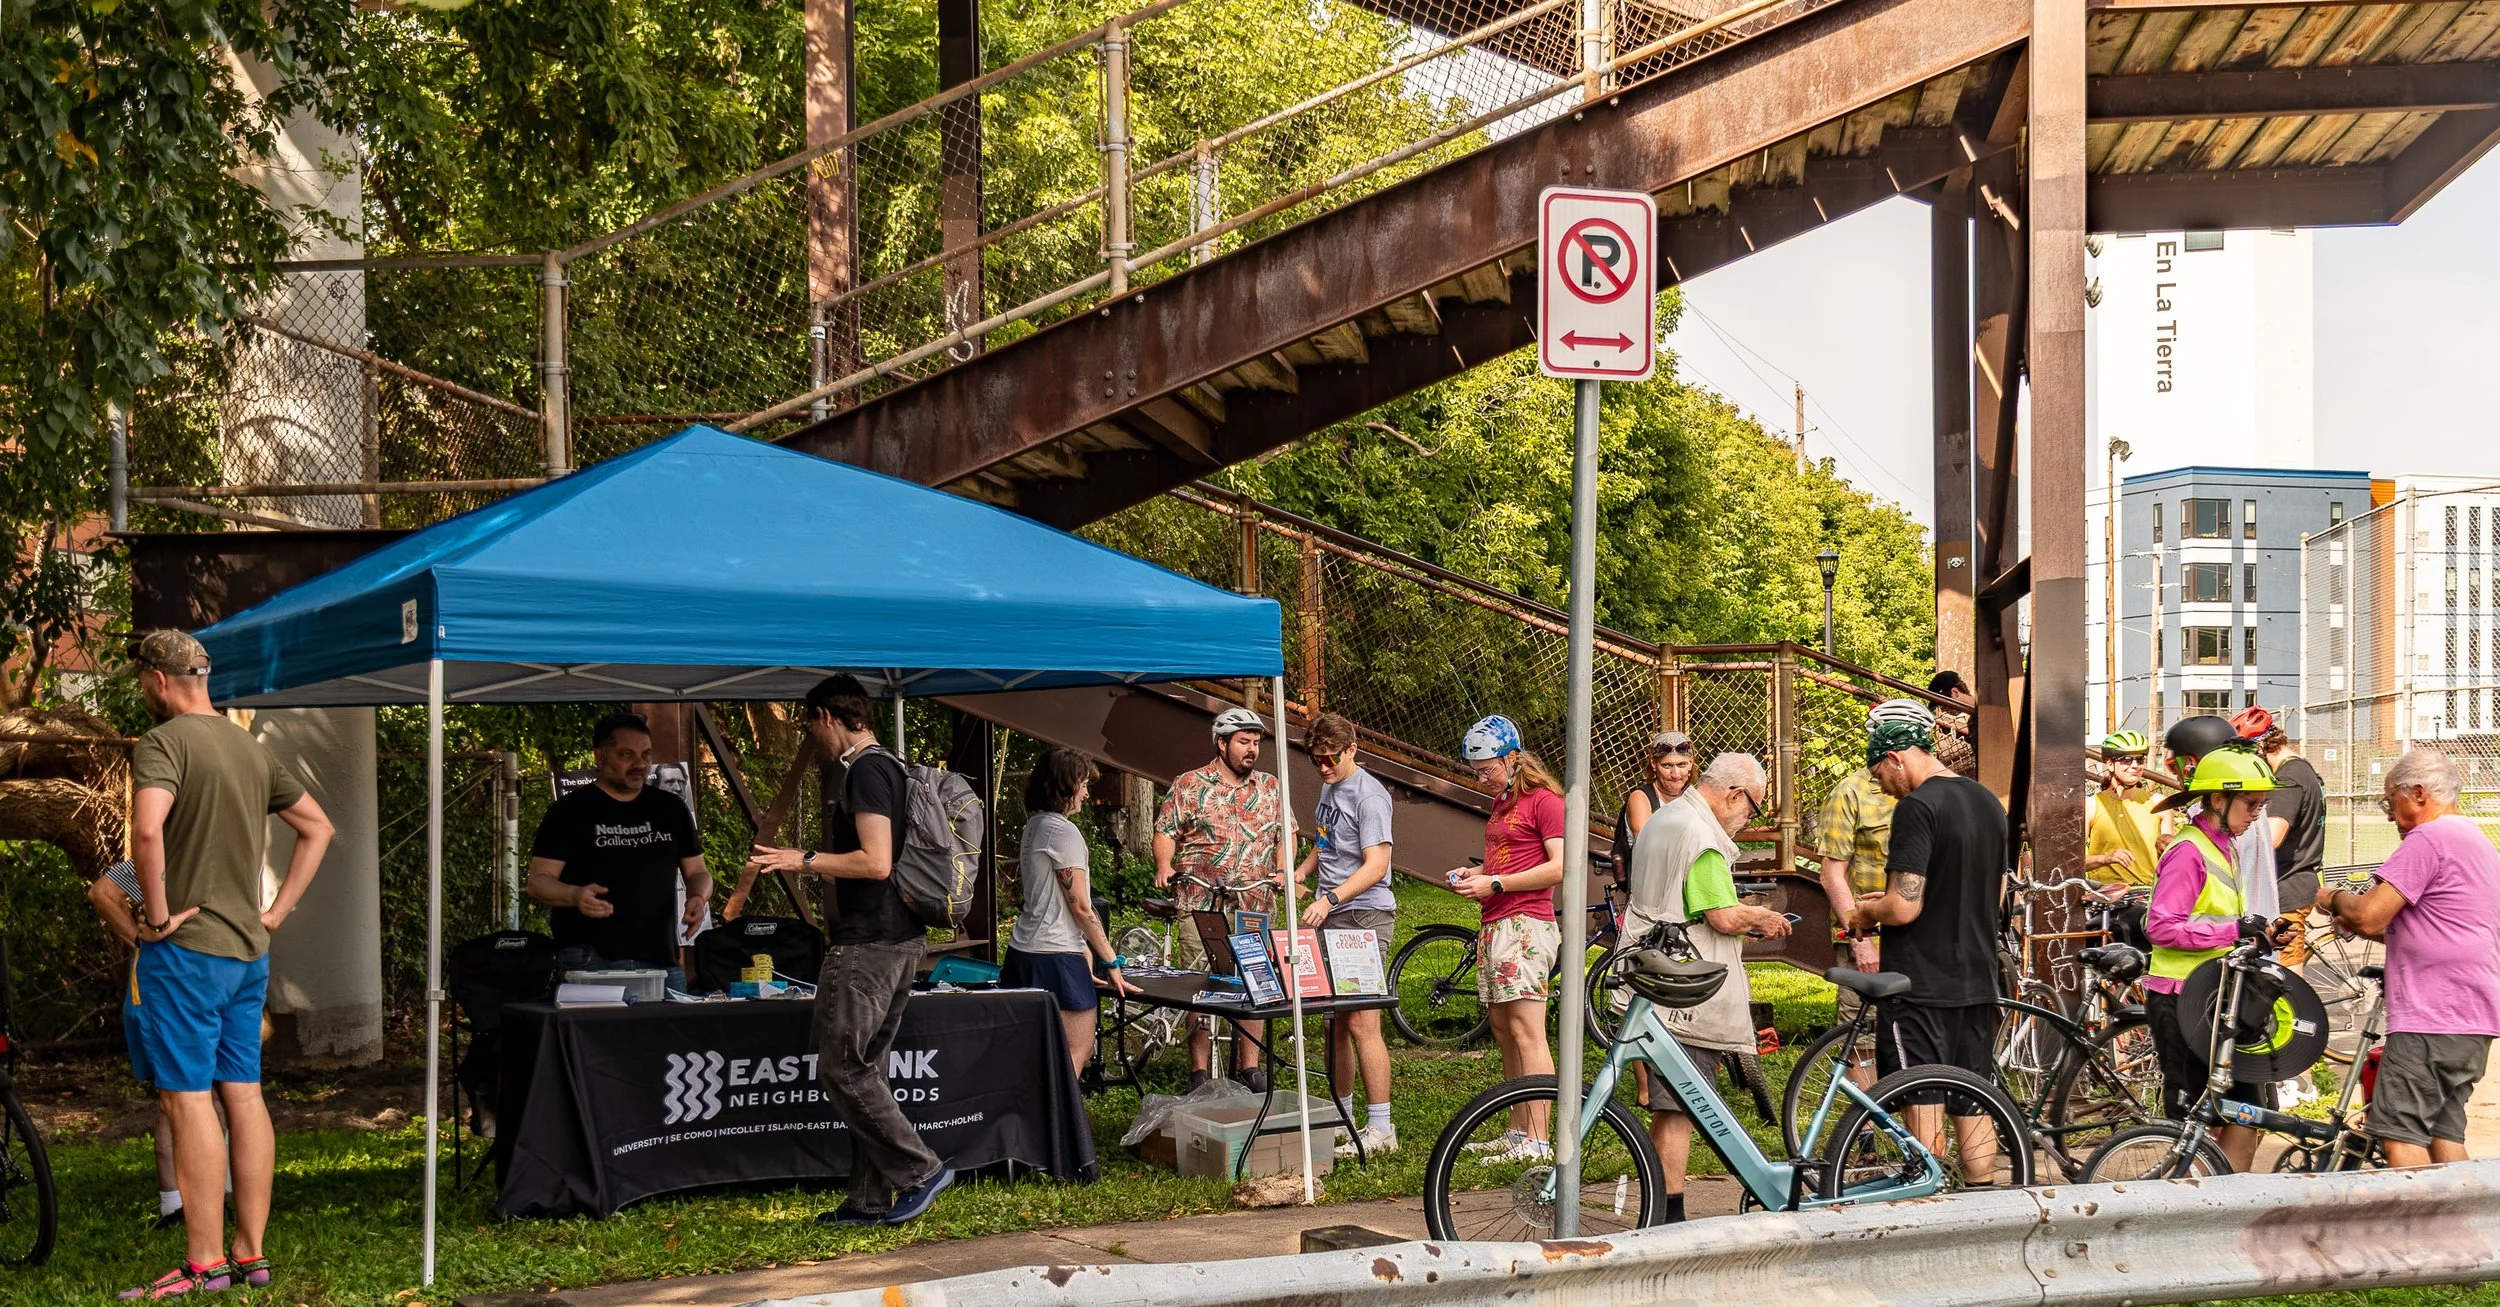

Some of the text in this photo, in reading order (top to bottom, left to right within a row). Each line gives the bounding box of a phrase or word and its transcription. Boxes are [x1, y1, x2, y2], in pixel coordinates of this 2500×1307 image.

[2157, 241, 2177, 393] En La Tierra
[595, 831, 673, 848] Gallery of Art
[596, 821, 652, 836] National
[729, 1049, 939, 1087] EAST NK
[729, 1087, 940, 1108] NEIGHBODS
[1678, 1081, 1731, 1138] AVENTON
[613, 1111, 984, 1156] UNIVERSITY SE COMO NICOLLET ISLAND-EAST BA MARCY-HOLMES
